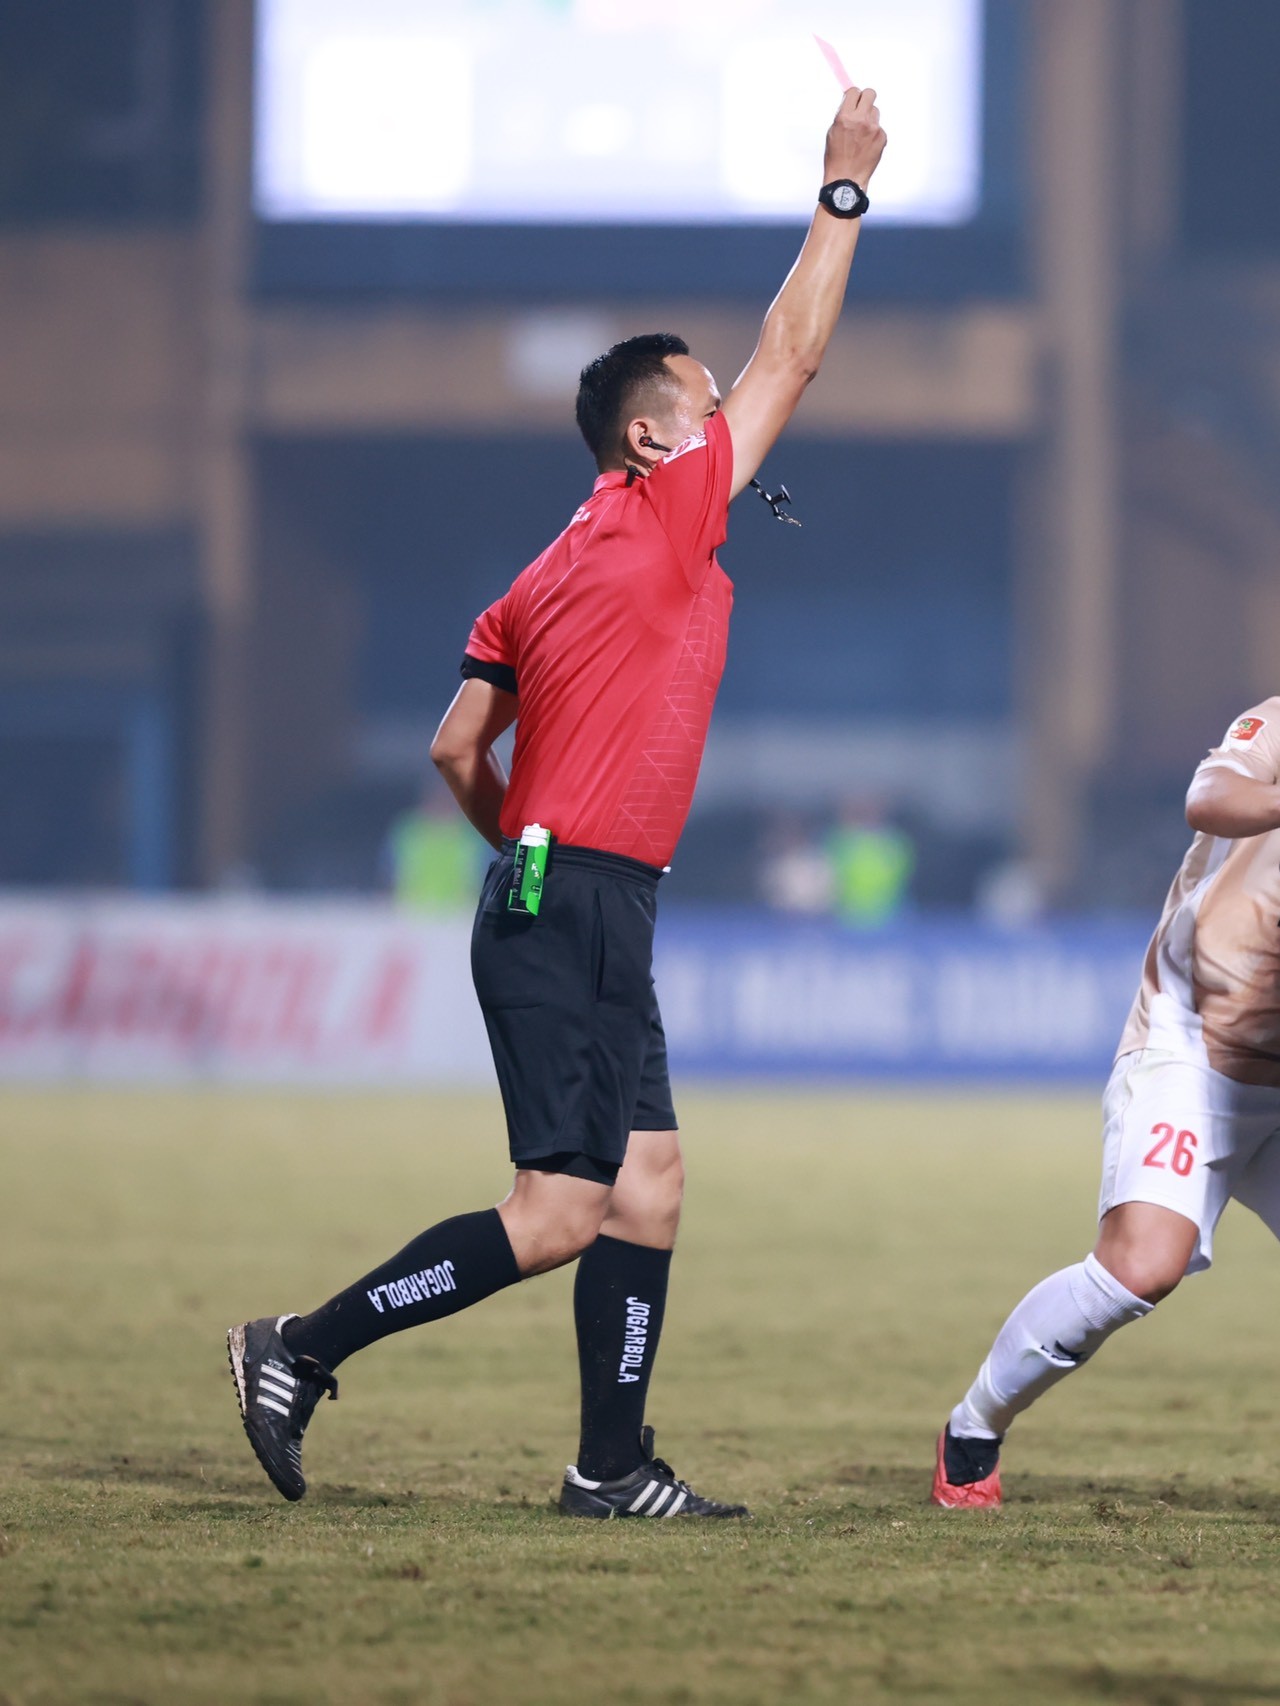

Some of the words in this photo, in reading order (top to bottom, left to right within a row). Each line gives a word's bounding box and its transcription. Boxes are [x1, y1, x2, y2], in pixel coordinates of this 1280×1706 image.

[1142, 1122, 1198, 1177] 26
[367, 1260, 456, 1313] JOGARBOLA
[617, 1296, 651, 1383] JOGARBOLA
